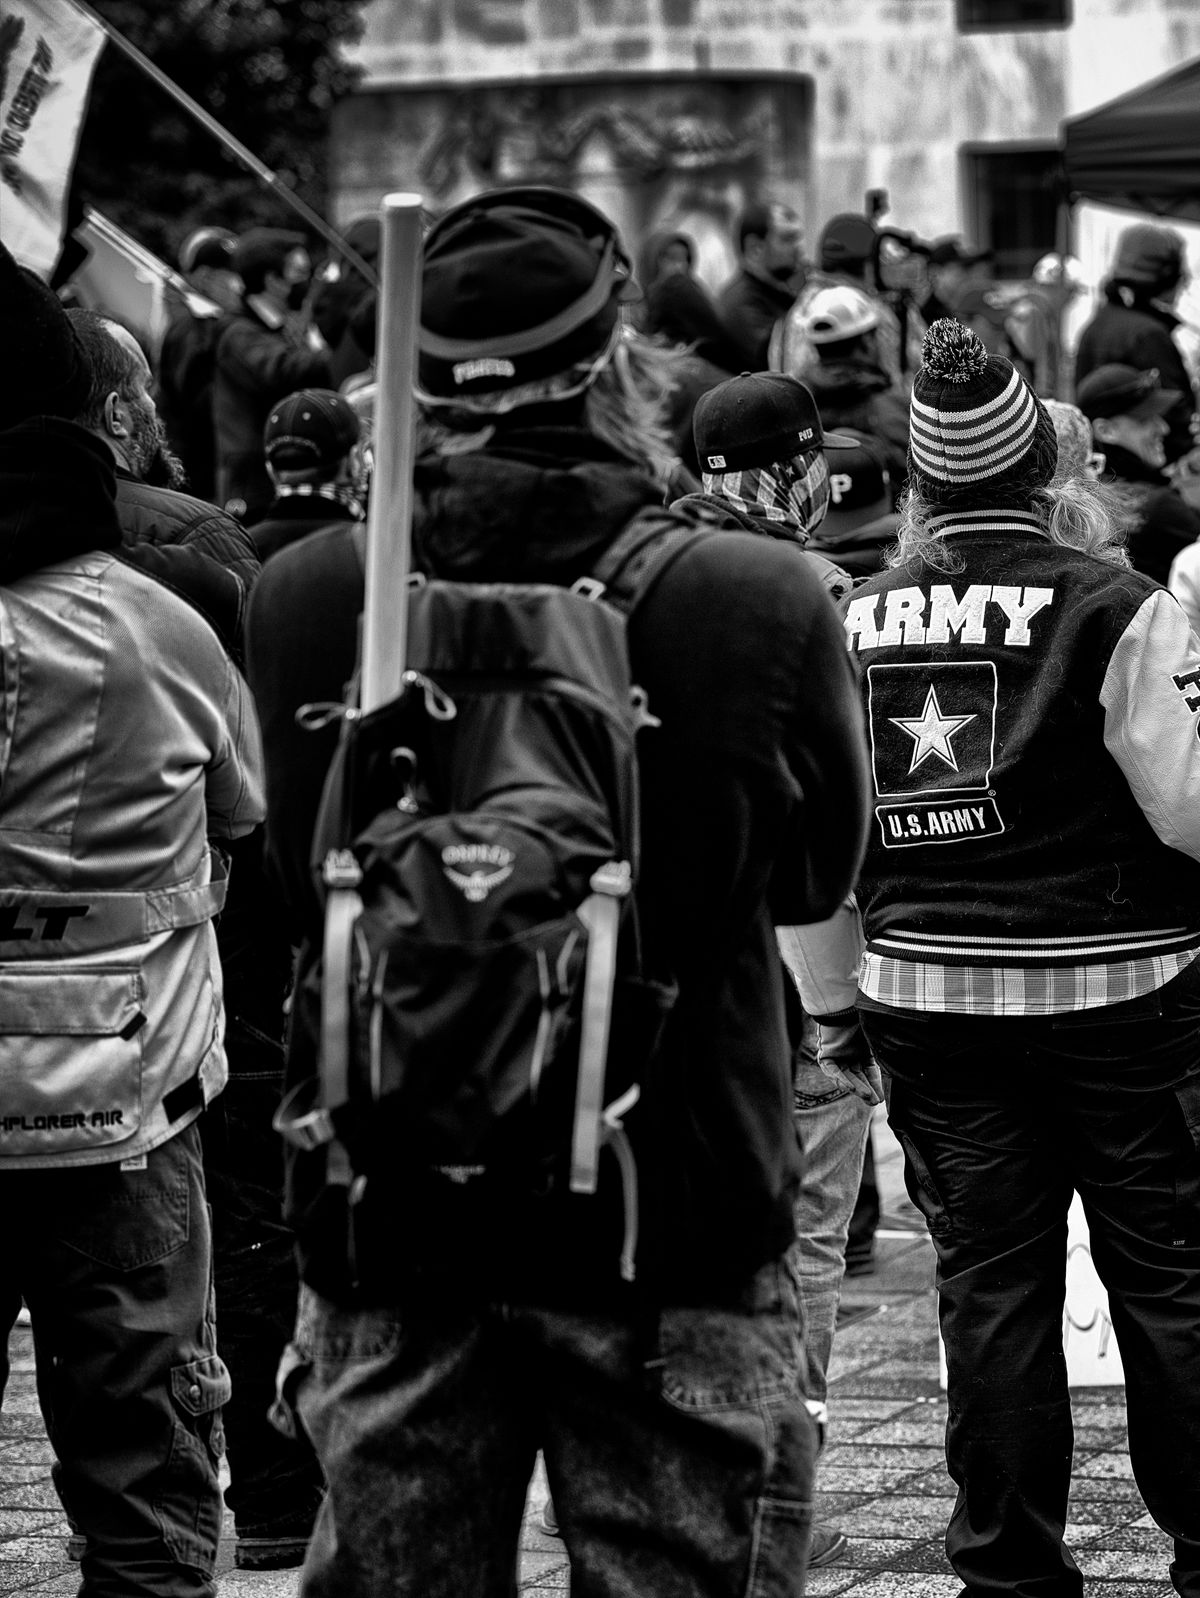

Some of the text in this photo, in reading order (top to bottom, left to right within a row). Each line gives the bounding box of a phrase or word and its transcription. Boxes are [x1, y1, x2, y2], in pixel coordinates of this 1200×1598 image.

[844, 584, 1054, 651] ARMY
[887, 806, 986, 839] U.S.ARMY
[90, 1109, 124, 1128] AIR
